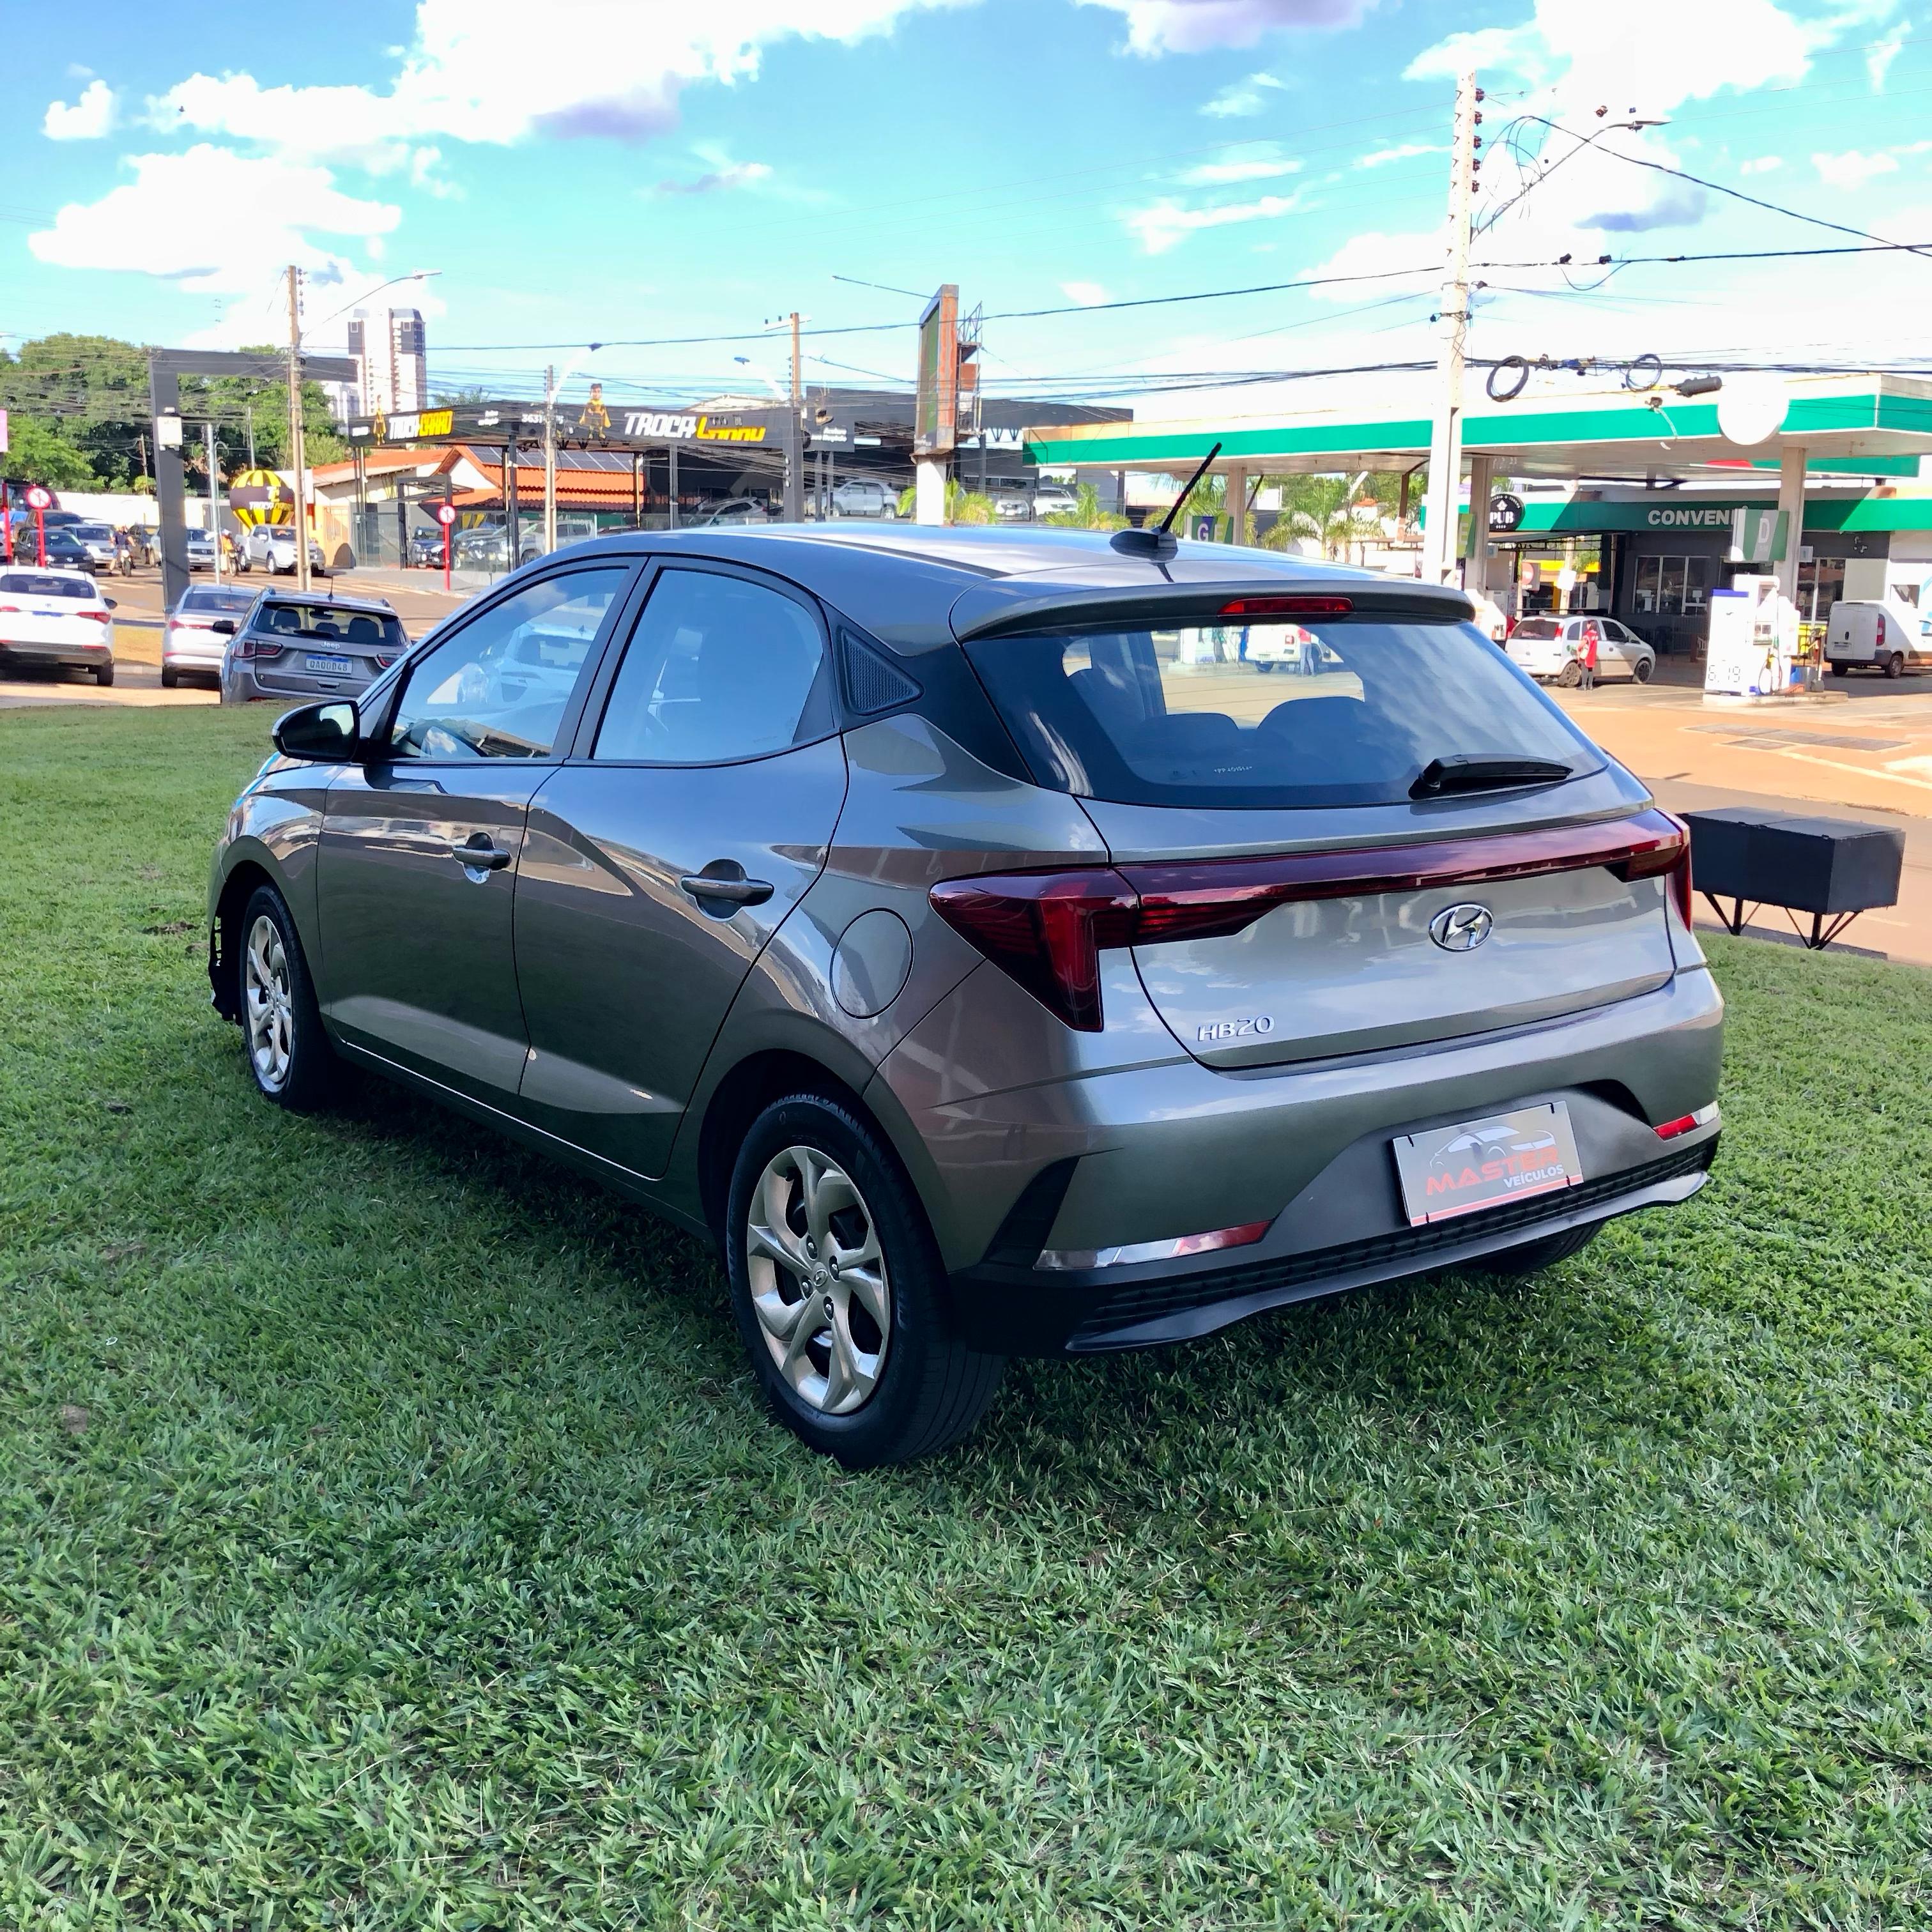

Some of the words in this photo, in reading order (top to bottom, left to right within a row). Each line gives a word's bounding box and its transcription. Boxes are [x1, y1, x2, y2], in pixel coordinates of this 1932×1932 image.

[624, 413, 696, 439] TROCA
[1489, 510, 1514, 524] PUB
[1197, 523, 1209, 542] G
[1758, 518, 1770, 543] D
[321, 641, 341, 650] Jeep
[1198, 1015, 1275, 1041] HB20
[1425, 1147, 1560, 1196] MASTER
[1503, 1164, 1565, 1188] VEÍCULOS
